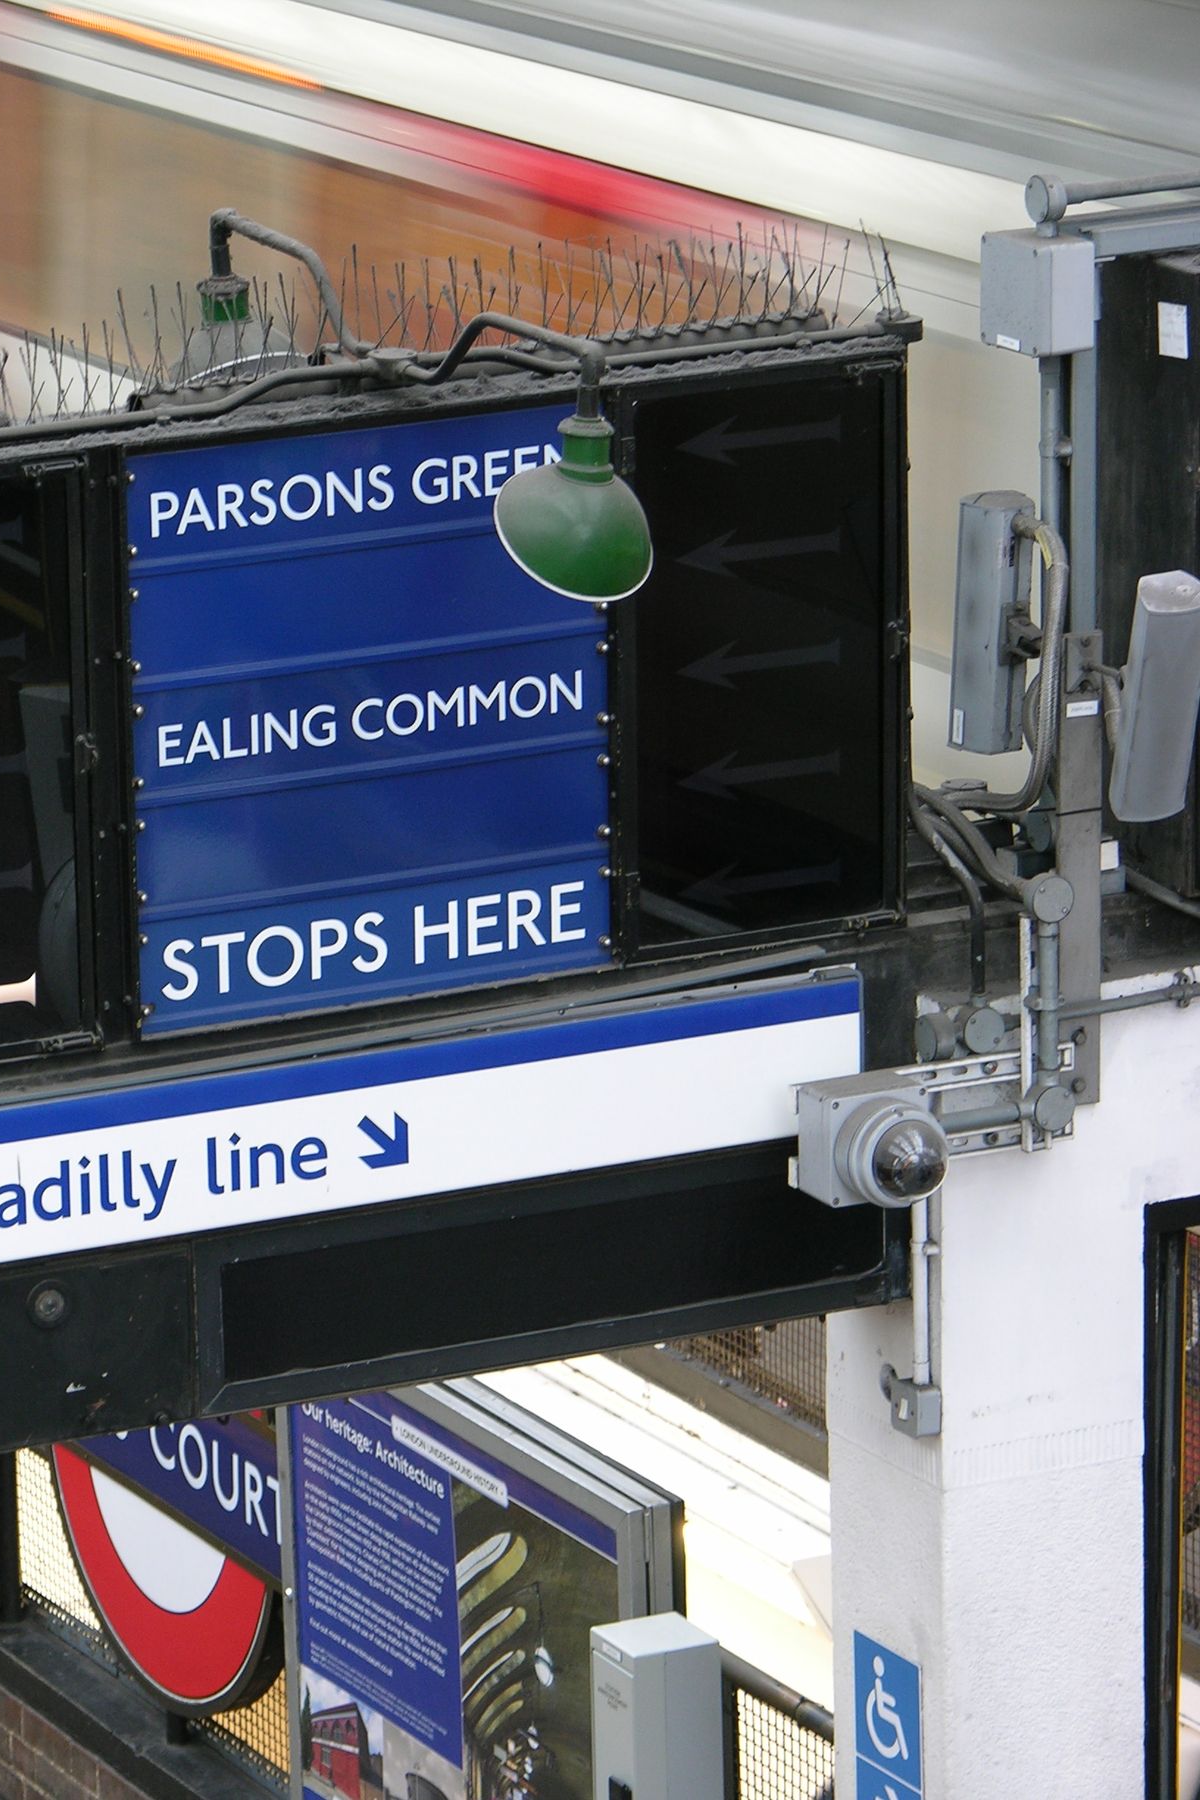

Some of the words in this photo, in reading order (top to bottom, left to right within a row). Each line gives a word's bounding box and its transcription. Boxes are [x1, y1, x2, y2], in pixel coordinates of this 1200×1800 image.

[151, 465, 394, 537] PARSONS
[412, 444, 561, 504] GREE
[159, 705, 336, 767] EALING
[352, 670, 582, 739] COMMON
[162, 912, 387, 1000] STOPS
[415, 881, 585, 964] HERE
[207, 1133, 327, 1194] line
[150, 1424, 281, 1544] COURT
[325, 1409, 373, 1454] heritage:
[375, 1440, 445, 1500] Architecture
